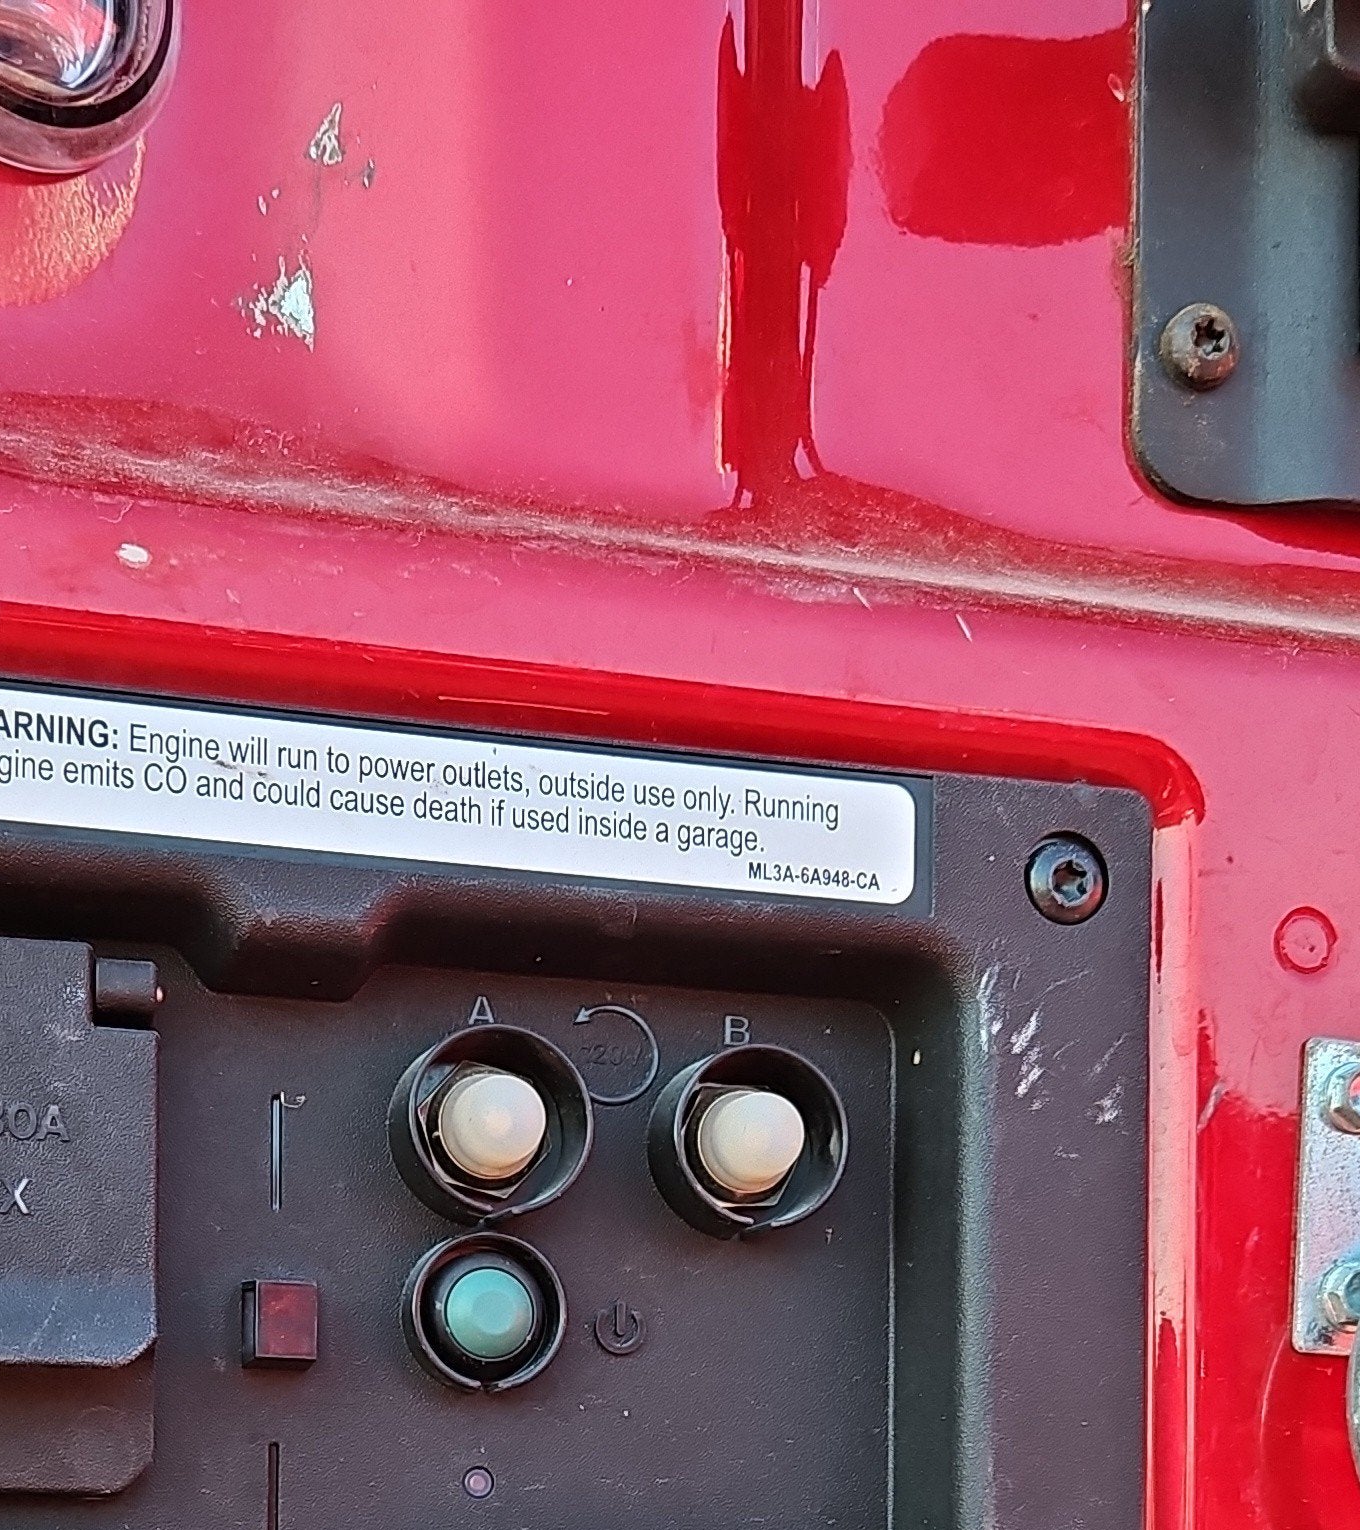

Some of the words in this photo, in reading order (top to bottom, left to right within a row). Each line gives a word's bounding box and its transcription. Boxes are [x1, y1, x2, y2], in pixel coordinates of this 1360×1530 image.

[129, 723, 220, 764] Engine
[228, 736, 268, 767] will
[278, 747, 317, 771] run
[327, 746, 349, 774] to
[359, 755, 435, 784] power
[443, 761, 529, 796] outlets,
[539, 772, 624, 803] outside
[634, 785, 675, 807] use
[684, 785, 734, 820] only.
[745, 789, 839, 831] Running
[64, 761, 134, 789] emits
[144, 763, 186, 794] CO
[196, 770, 243, 800] and
[253, 777, 320, 808] could
[330, 790, 404, 816] cause
[414, 791, 481, 824] death
[492, 799, 505, 826] if
[513, 804, 569, 833] used
[579, 810, 647, 840] inside
[656, 823, 668, 843] a
[678, 825, 764, 857] garage.
[749, 862, 880, 890] ML3A-6A948-CA
[467, 995, 496, 1025] A
[723, 1014, 751, 1048] B
